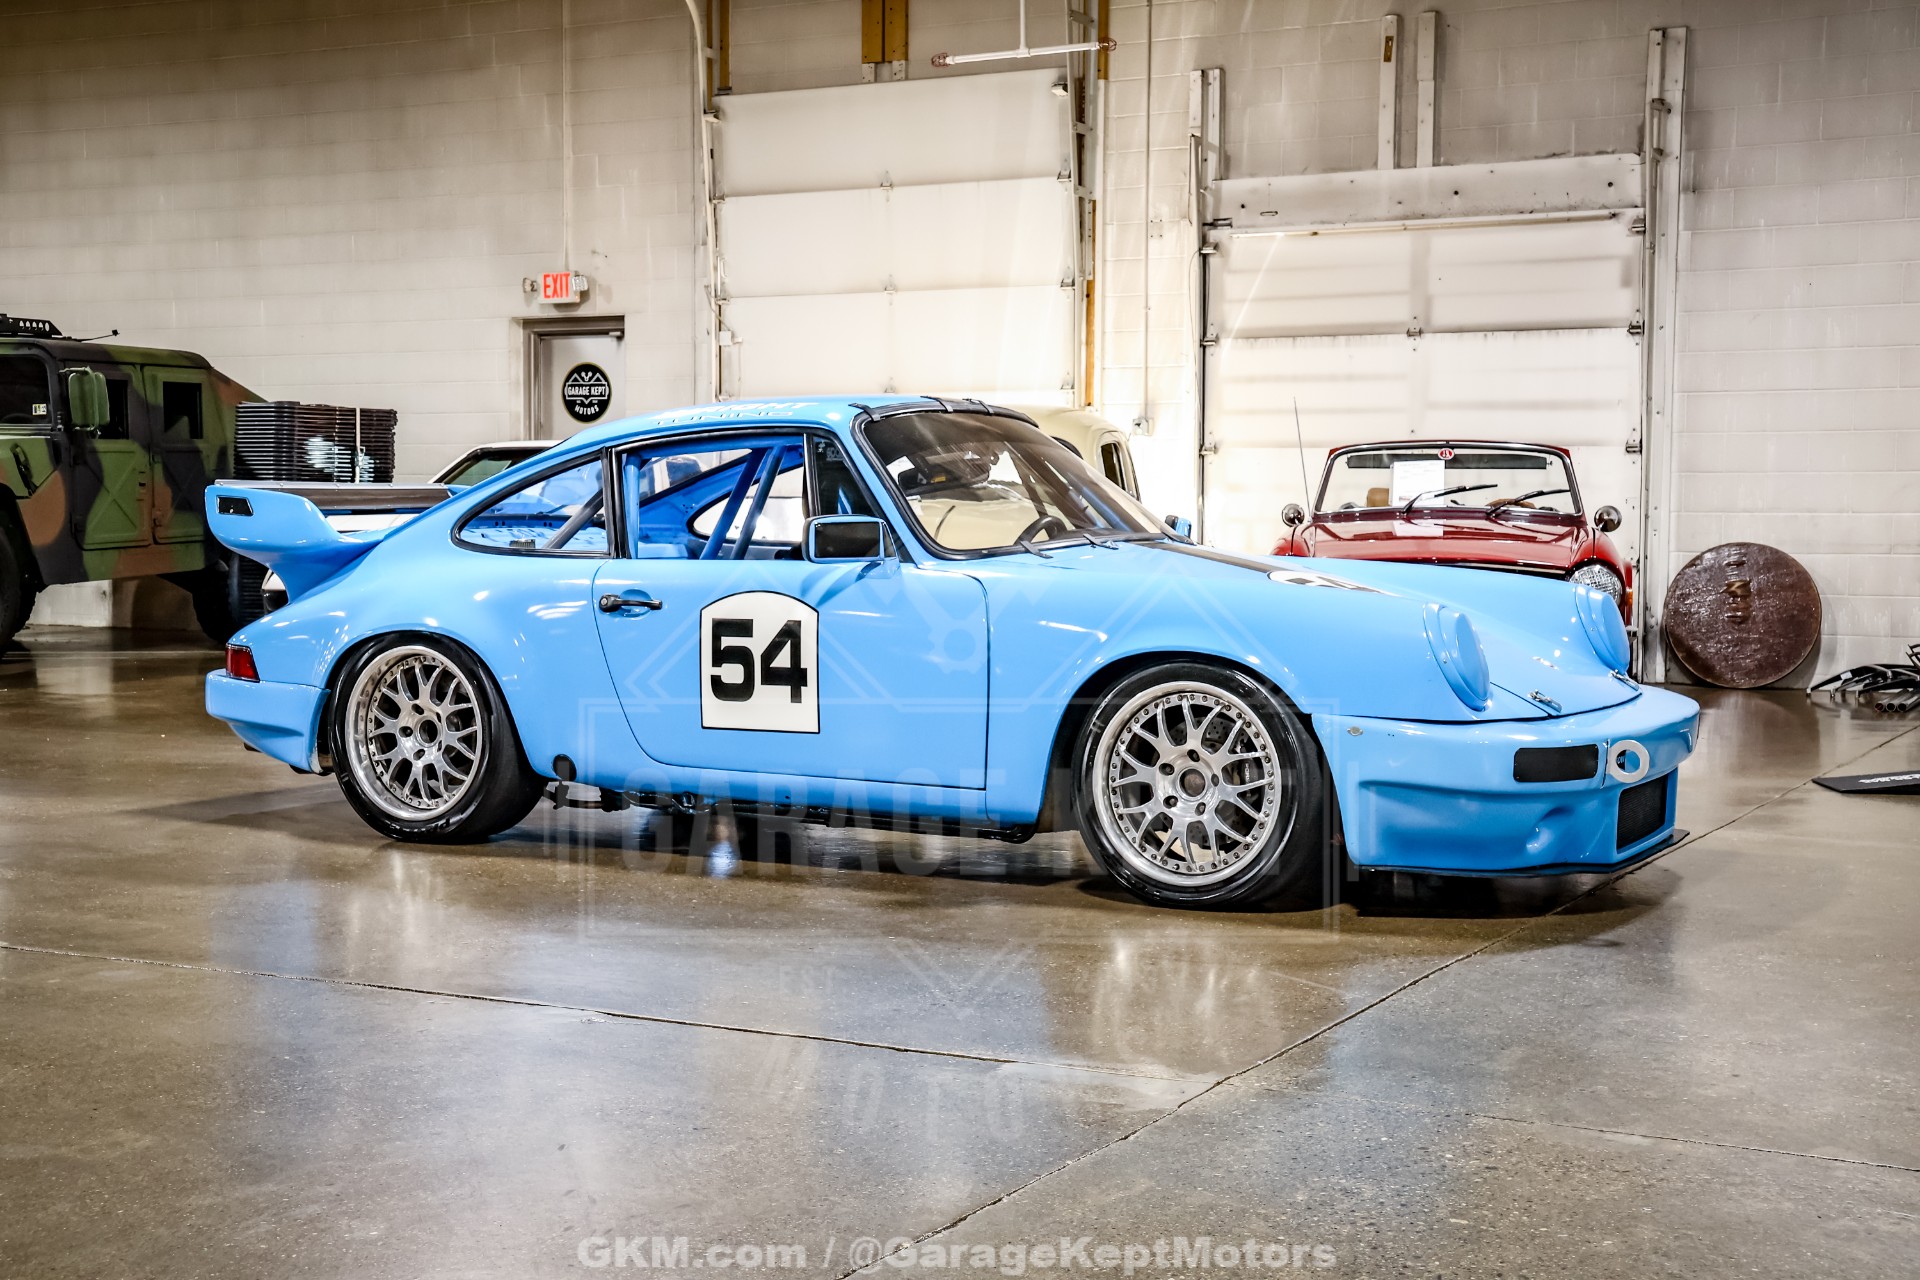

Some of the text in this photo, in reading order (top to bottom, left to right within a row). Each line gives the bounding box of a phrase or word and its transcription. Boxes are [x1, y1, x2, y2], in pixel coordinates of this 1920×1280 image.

[543, 272, 570, 299] EXIT
[567, 386, 606, 396] GARAGE KEPT
[575, 404, 600, 416] MOTORS
[710, 617, 808, 704] 54
